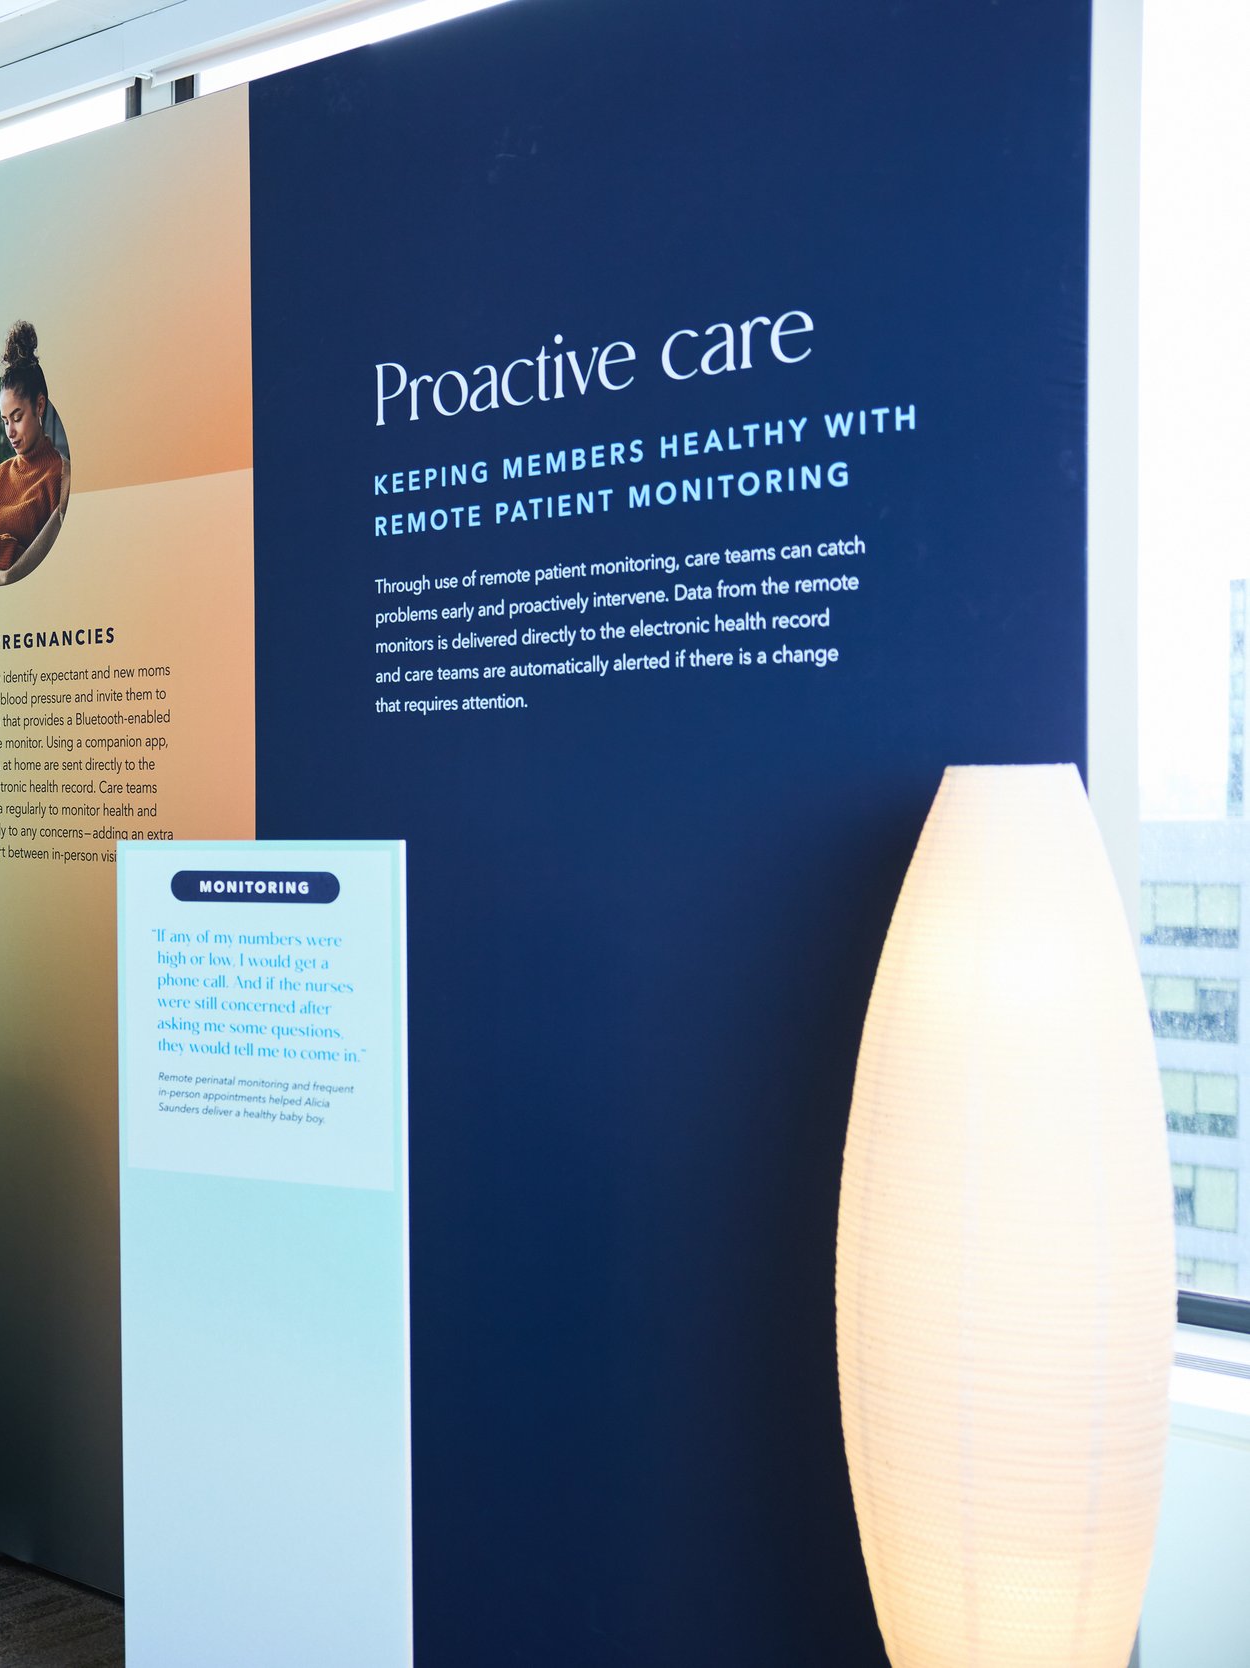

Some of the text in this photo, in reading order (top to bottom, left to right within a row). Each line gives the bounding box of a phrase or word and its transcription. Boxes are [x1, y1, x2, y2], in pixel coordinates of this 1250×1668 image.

[375, 310, 814, 426] Proactive care
[375, 404, 916, 496] KEEPING MEMBERS HEALTHY WITH
[375, 461, 849, 537] REMOTE PATIENT MONITORING
[375, 534, 866, 596] Through use of remote patient monitoring, care teams can catch
[3, 669, 38, 686] identify
[40, 669, 89, 685] expectant
[91, 665, 110, 680] and
[114, 669, 135, 679] new
[138, 666, 171, 677] moms
[0, 691, 28, 706] blood
[31, 694, 72, 708] pressure
[75, 689, 93, 703] and
[97, 689, 123, 702] invite
[125, 687, 152, 701] them
[155, 689, 166, 700] to
[375, 693, 528, 716] that requires attention.
[3, 714, 21, 727] that
[23, 713, 64, 730] provides
[67, 717, 73, 726] a
[76, 709, 170, 726] Bluetooth-enabled
[200, 880, 309, 894] MONITORING
[170, 933, 191, 947] any
[196, 930, 210, 943] of
[214, 934, 232, 948] my
[239, 931, 302, 946] numbers
[306, 937, 342, 947] were
[158, 951, 186, 968] high
[190, 956, 205, 965] or
[240, 953, 244, 967] I
[248, 954, 290, 968] would
[295, 958, 316, 973] get
[321, 960, 329, 970] a
[158, 1072, 354, 1095] Remote perinatal monitoring and frequent
